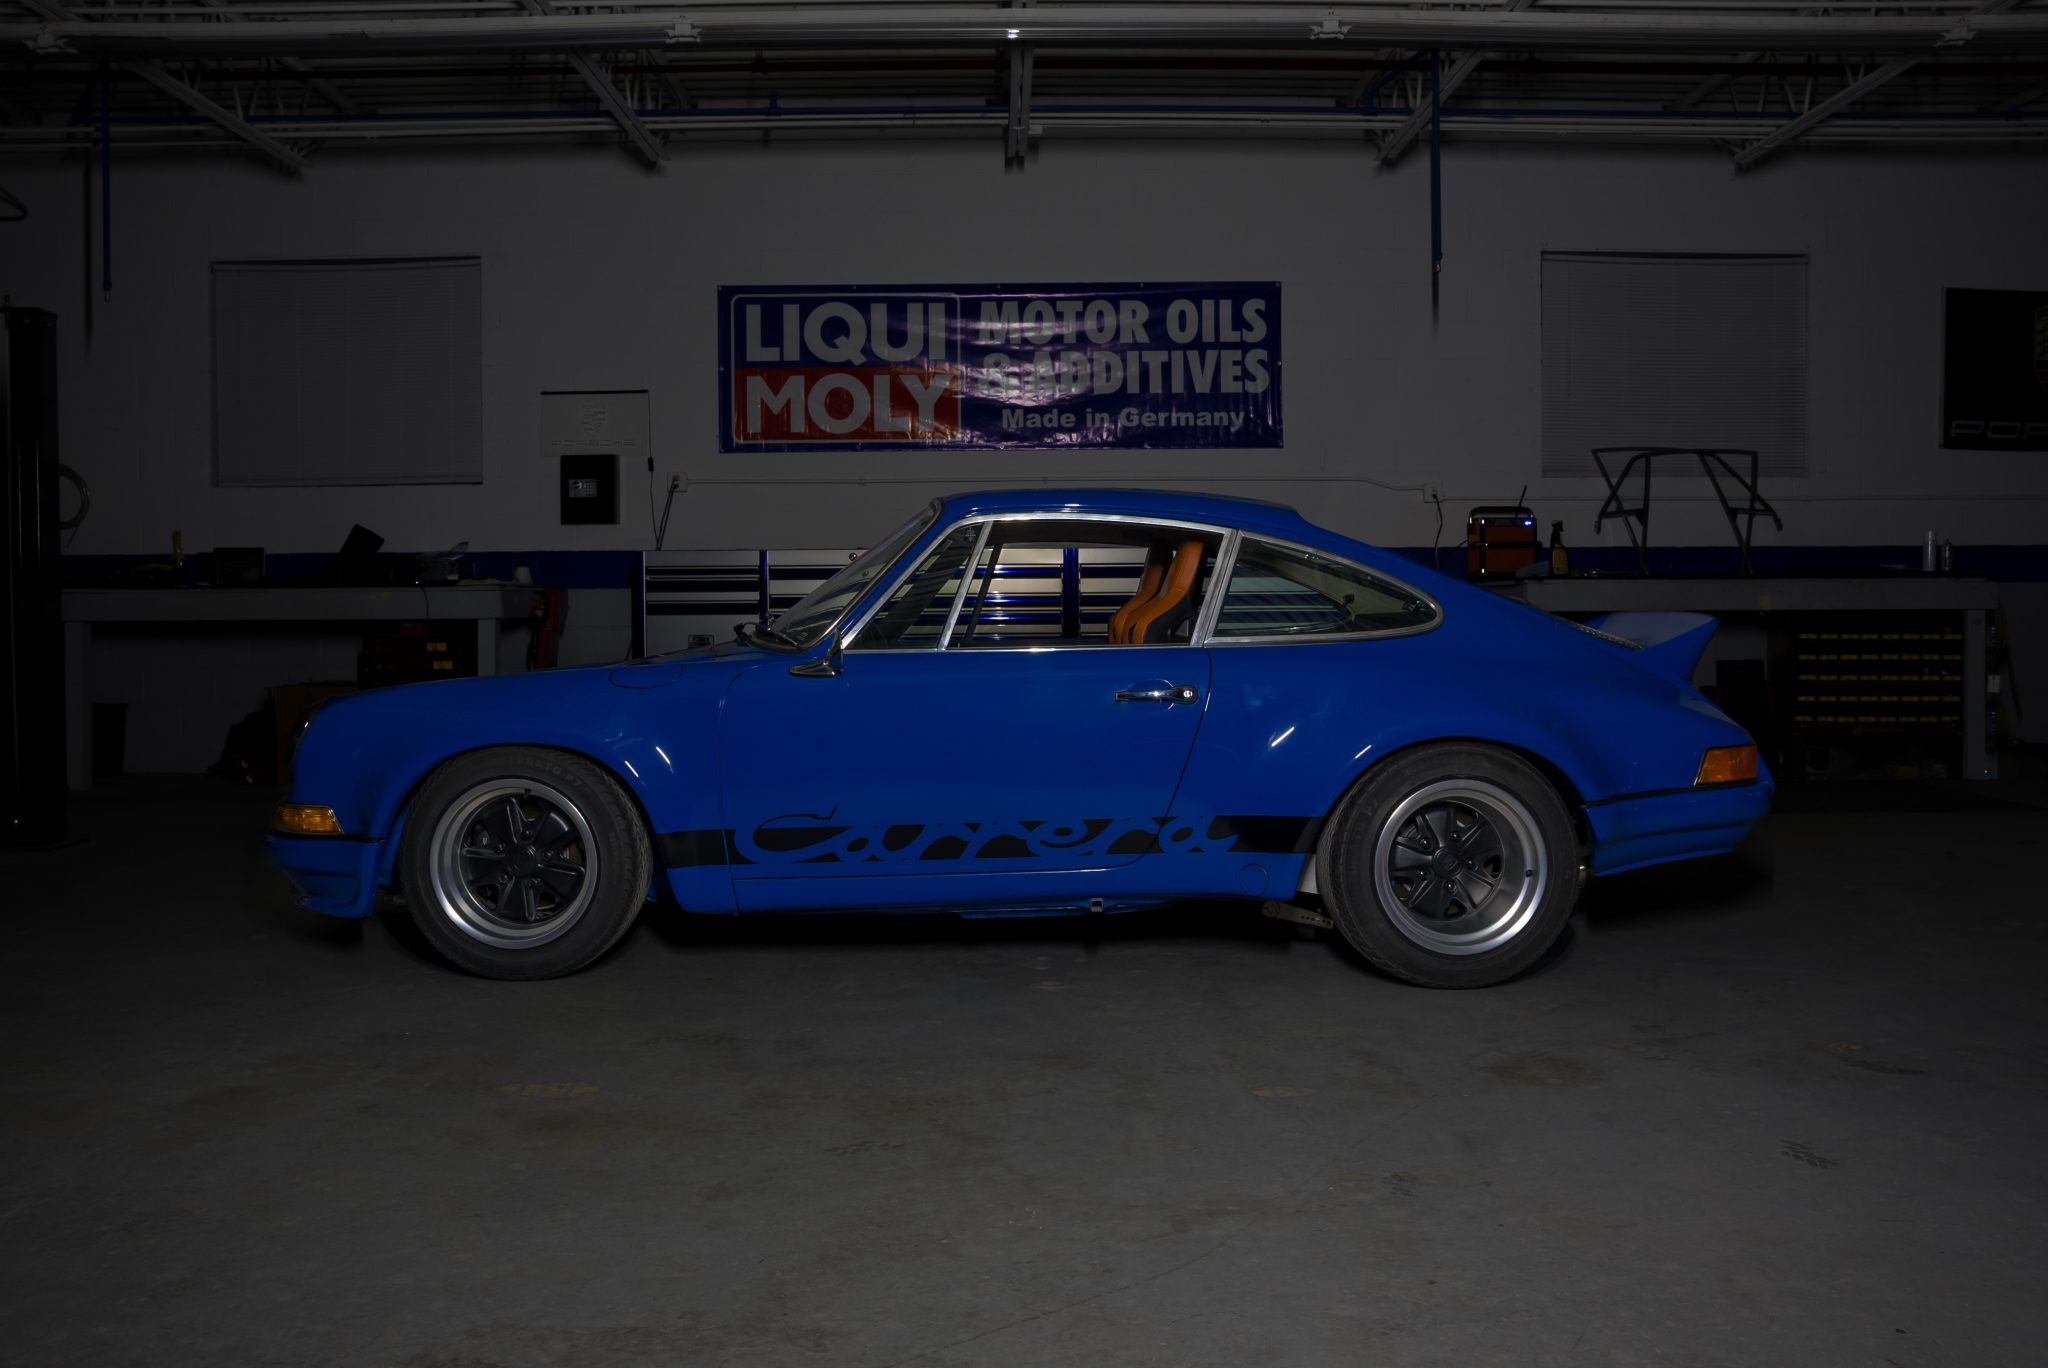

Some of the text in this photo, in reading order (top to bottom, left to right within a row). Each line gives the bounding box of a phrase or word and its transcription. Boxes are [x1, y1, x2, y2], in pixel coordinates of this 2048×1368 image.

[746, 302, 946, 366] LIQUI
[979, 298, 1267, 345] MOTOR OILS
[976, 349, 1270, 394] & ADDITIVES
[746, 373, 951, 434] MOLY
[1002, 407, 1245, 432] Made in Germany
[734, 803, 1239, 866] Carrera
